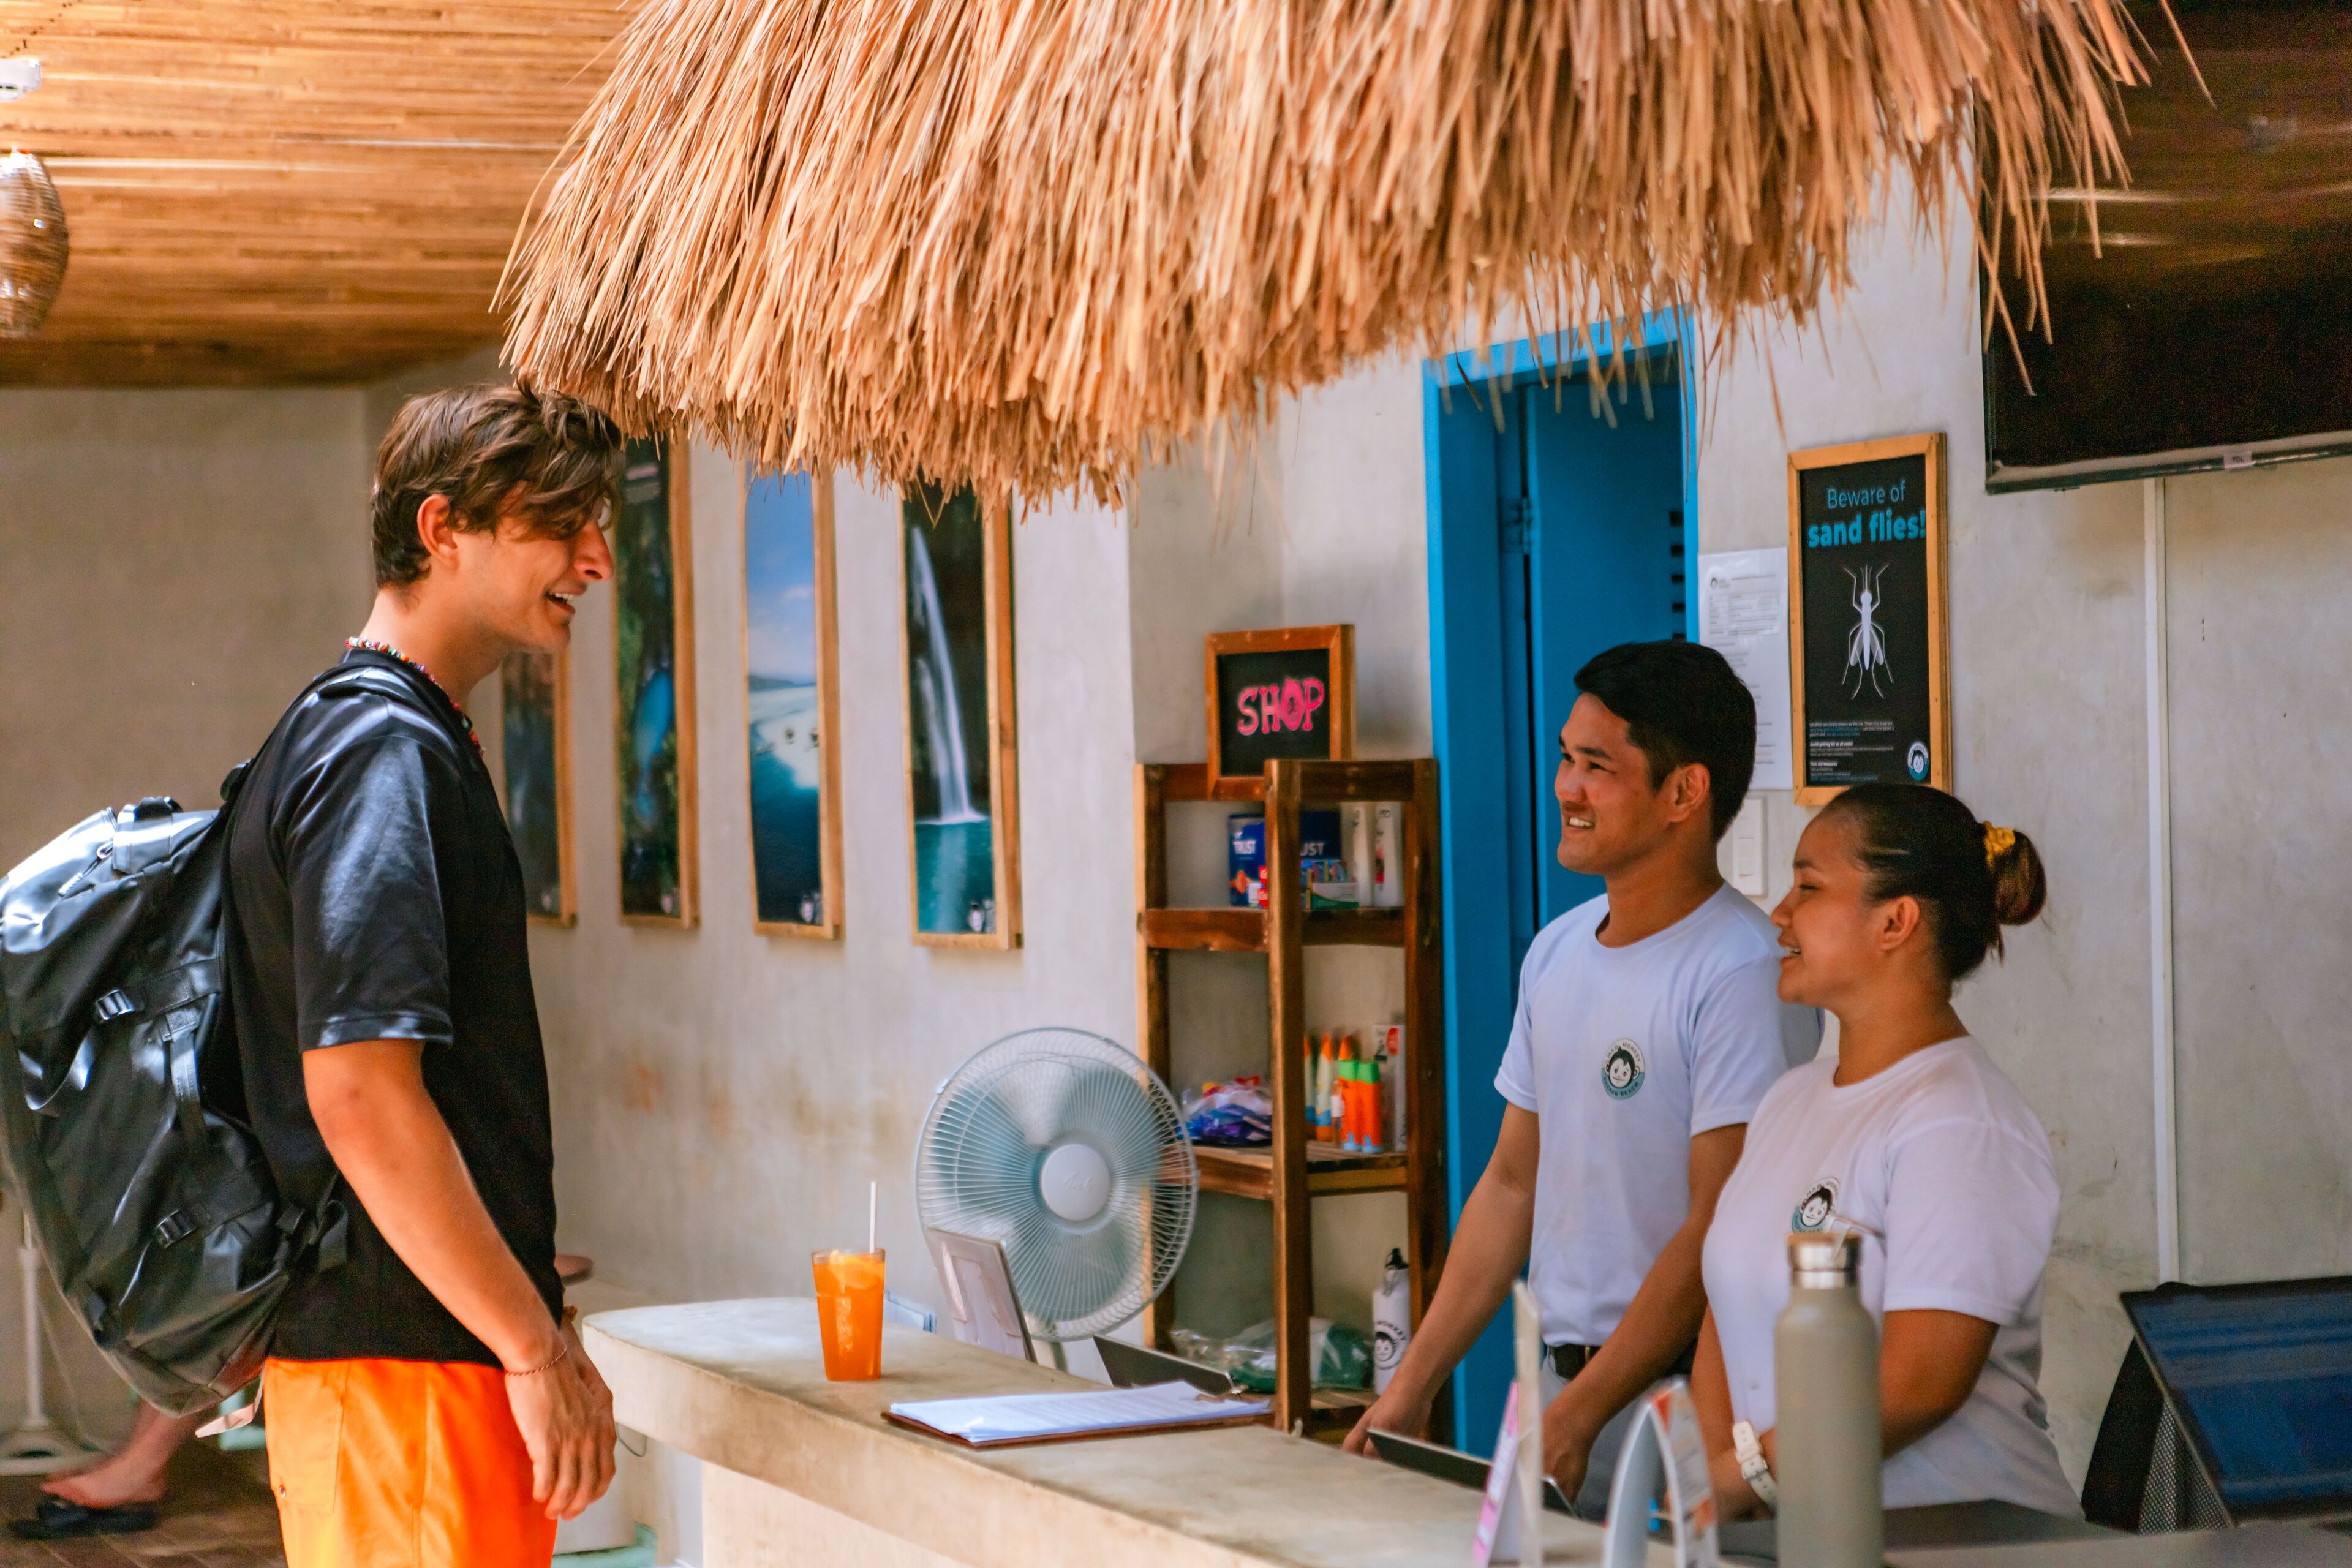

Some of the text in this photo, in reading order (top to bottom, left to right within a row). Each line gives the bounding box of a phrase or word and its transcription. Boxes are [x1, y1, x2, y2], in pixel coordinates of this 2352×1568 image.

[1826, 480, 1906, 509] Beware of
[1808, 508, 1926, 548] sand flies!
[1237, 677, 1324, 736] SHOP
[1233, 840, 1256, 854] TRUST
[1300, 842, 1325, 856] UST
[1623, 1043, 1641, 1062] MONKEY
